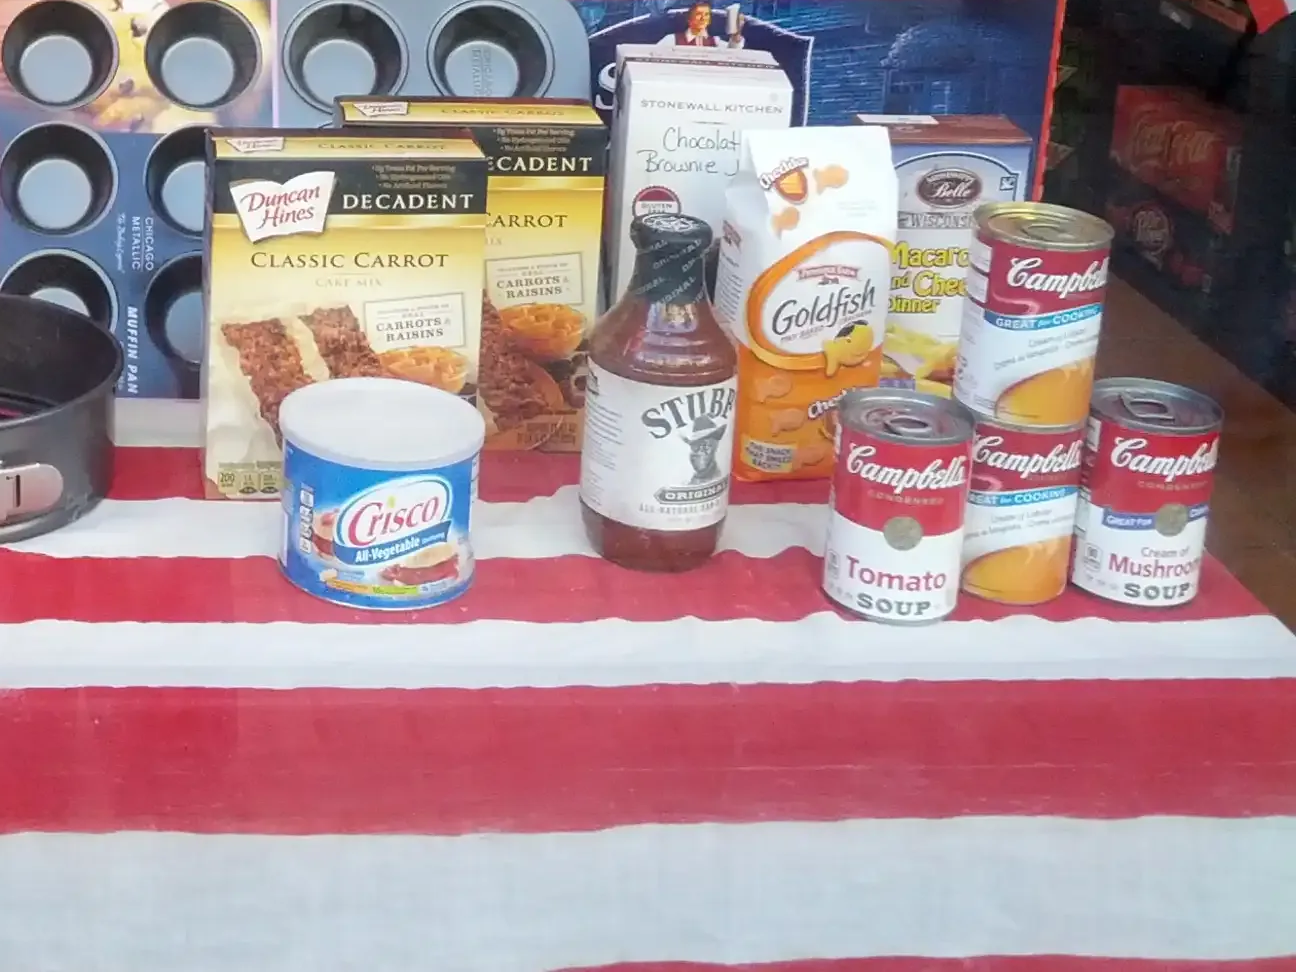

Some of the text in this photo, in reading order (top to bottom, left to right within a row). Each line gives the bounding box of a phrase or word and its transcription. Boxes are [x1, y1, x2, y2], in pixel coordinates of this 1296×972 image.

[640, 98, 784, 115] STONEWALL KITCHEN
[662, 126, 742, 153] Chocolat
[636, 149, 718, 174] Brownie
[239, 185, 321, 213] Duncan
[931, 182, 973, 199] Belle
[342, 194, 474, 210] DECADENT
[256, 205, 315, 230] Hines
[487, 212, 568, 228] ARROT
[910, 212, 976, 228] WISCONSI
[131, 216, 141, 271] METALLIC
[145, 217, 154, 271] CHICAGO
[250, 252, 449, 268] CLASSIC CARROT
[891, 241, 970, 269] Macaro
[496, 276, 561, 290] CARROTS
[891, 271, 912, 291] nd
[505, 286, 563, 299] RAISINS
[772, 278, 876, 337] Goldfish
[376, 317, 442, 332] CARROTS
[995, 318, 1036, 329] GREAT
[386, 329, 445, 343] RAISINS
[127, 305, 139, 394] MUFFIN PAN
[664, 479, 728, 501] ORIGINA
[867, 488, 945, 505] CONDENSED
[968, 494, 998, 505] REAT
[347, 494, 441, 547] Crisco
[354, 537, 422, 563] All-Vegetable
[1140, 545, 1191, 558] Cream of
[846, 554, 947, 592] Tomato
[1108, 553, 1202, 579] Mushroo
[1124, 582, 1191, 600] SOUP
[857, 592, 931, 616] SOUP
